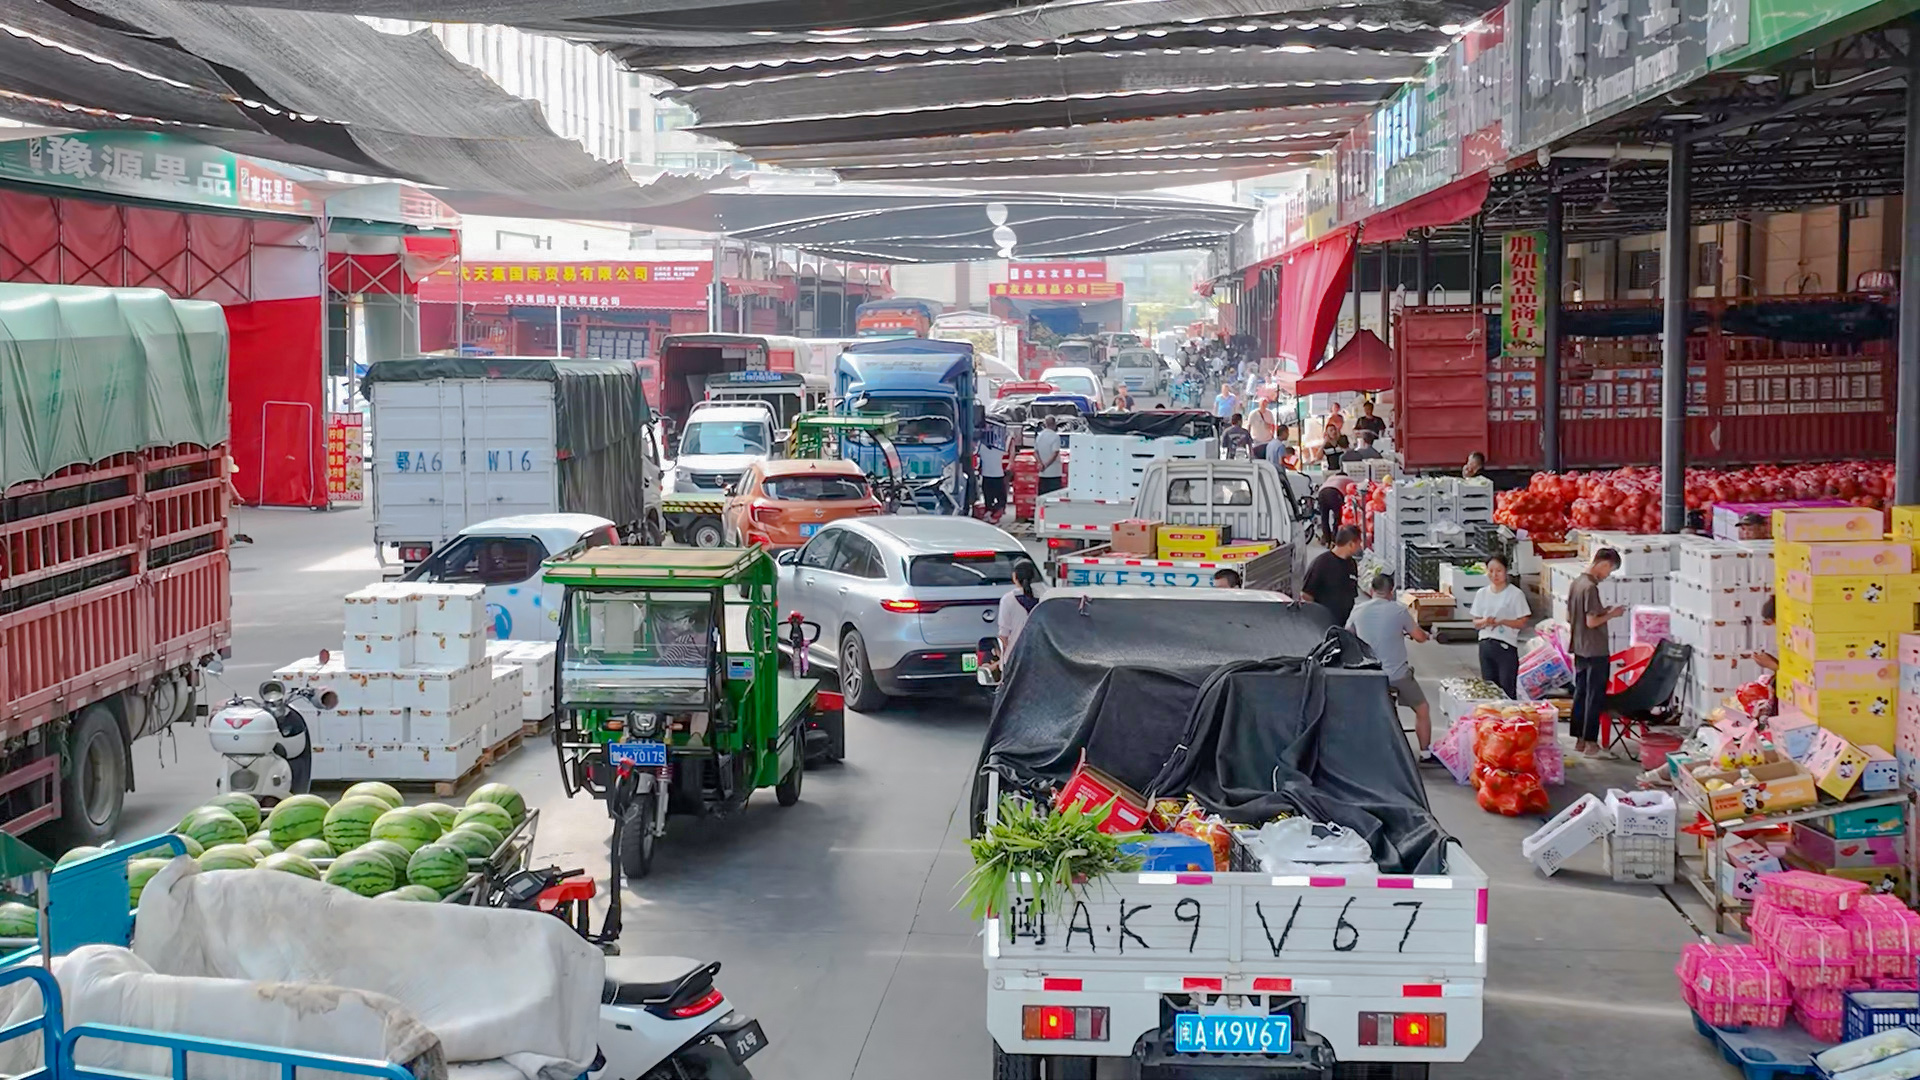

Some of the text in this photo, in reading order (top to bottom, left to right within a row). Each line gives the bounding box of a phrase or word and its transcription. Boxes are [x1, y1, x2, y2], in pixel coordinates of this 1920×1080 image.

[47, 136, 231, 198] 豫源果品
[736, 1031, 757, 1055] 九号
